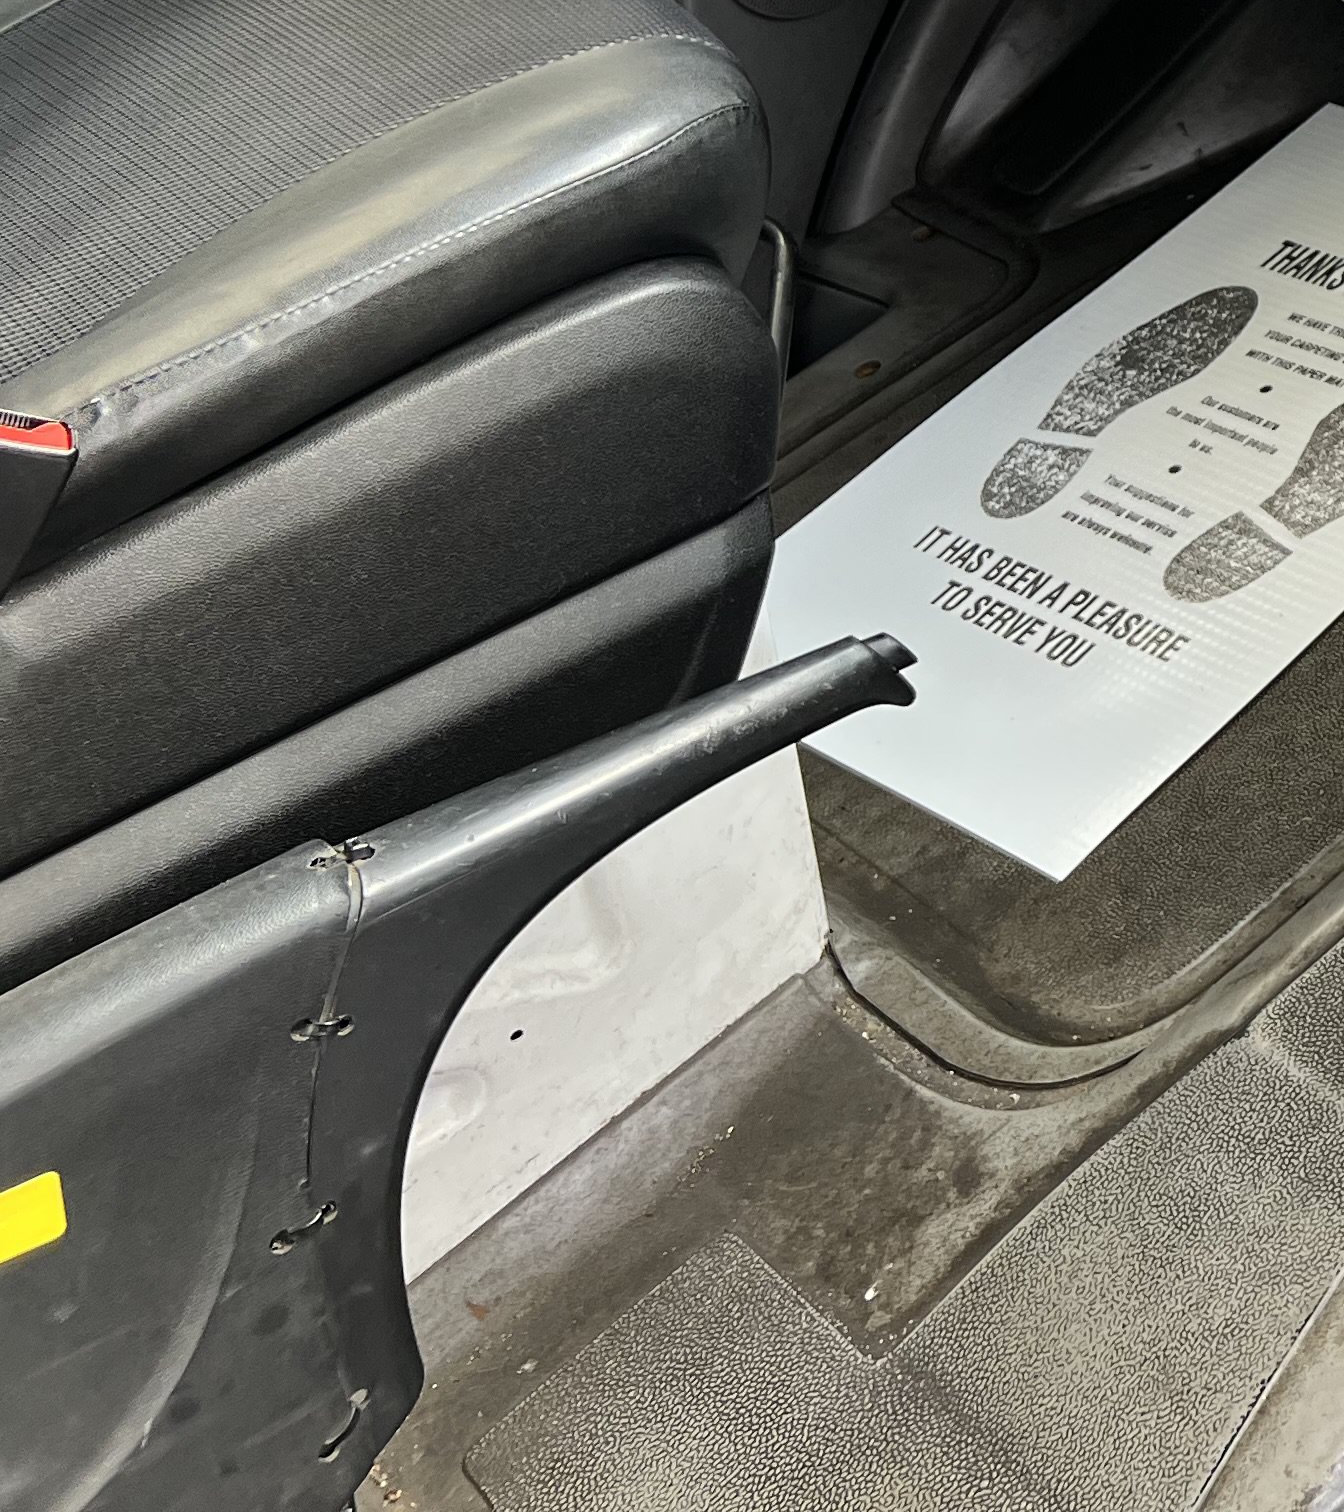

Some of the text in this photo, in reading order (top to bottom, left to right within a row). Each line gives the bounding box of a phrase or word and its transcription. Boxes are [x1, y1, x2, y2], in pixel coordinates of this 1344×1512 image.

[1264, 329, 1294, 345] YOUR
[1287, 312, 1307, 324] WE
[1303, 317, 1332, 332] HAVE
[1245, 348, 1274, 363] WITH
[1271, 356, 1297, 370] THIS
[1293, 363, 1327, 381] PAPER
[1201, 395, 1280, 431] Our customers are
[1180, 412, 1207, 426] most
[1203, 419, 1249, 443] important
[1243, 437, 1279, 455] people
[1124, 484, 1180, 512] suggestions
[913, 525, 1192, 662] IT HAS BEEN A PLEASURE
[930, 579, 1096, 668] TO SERVE YOU
